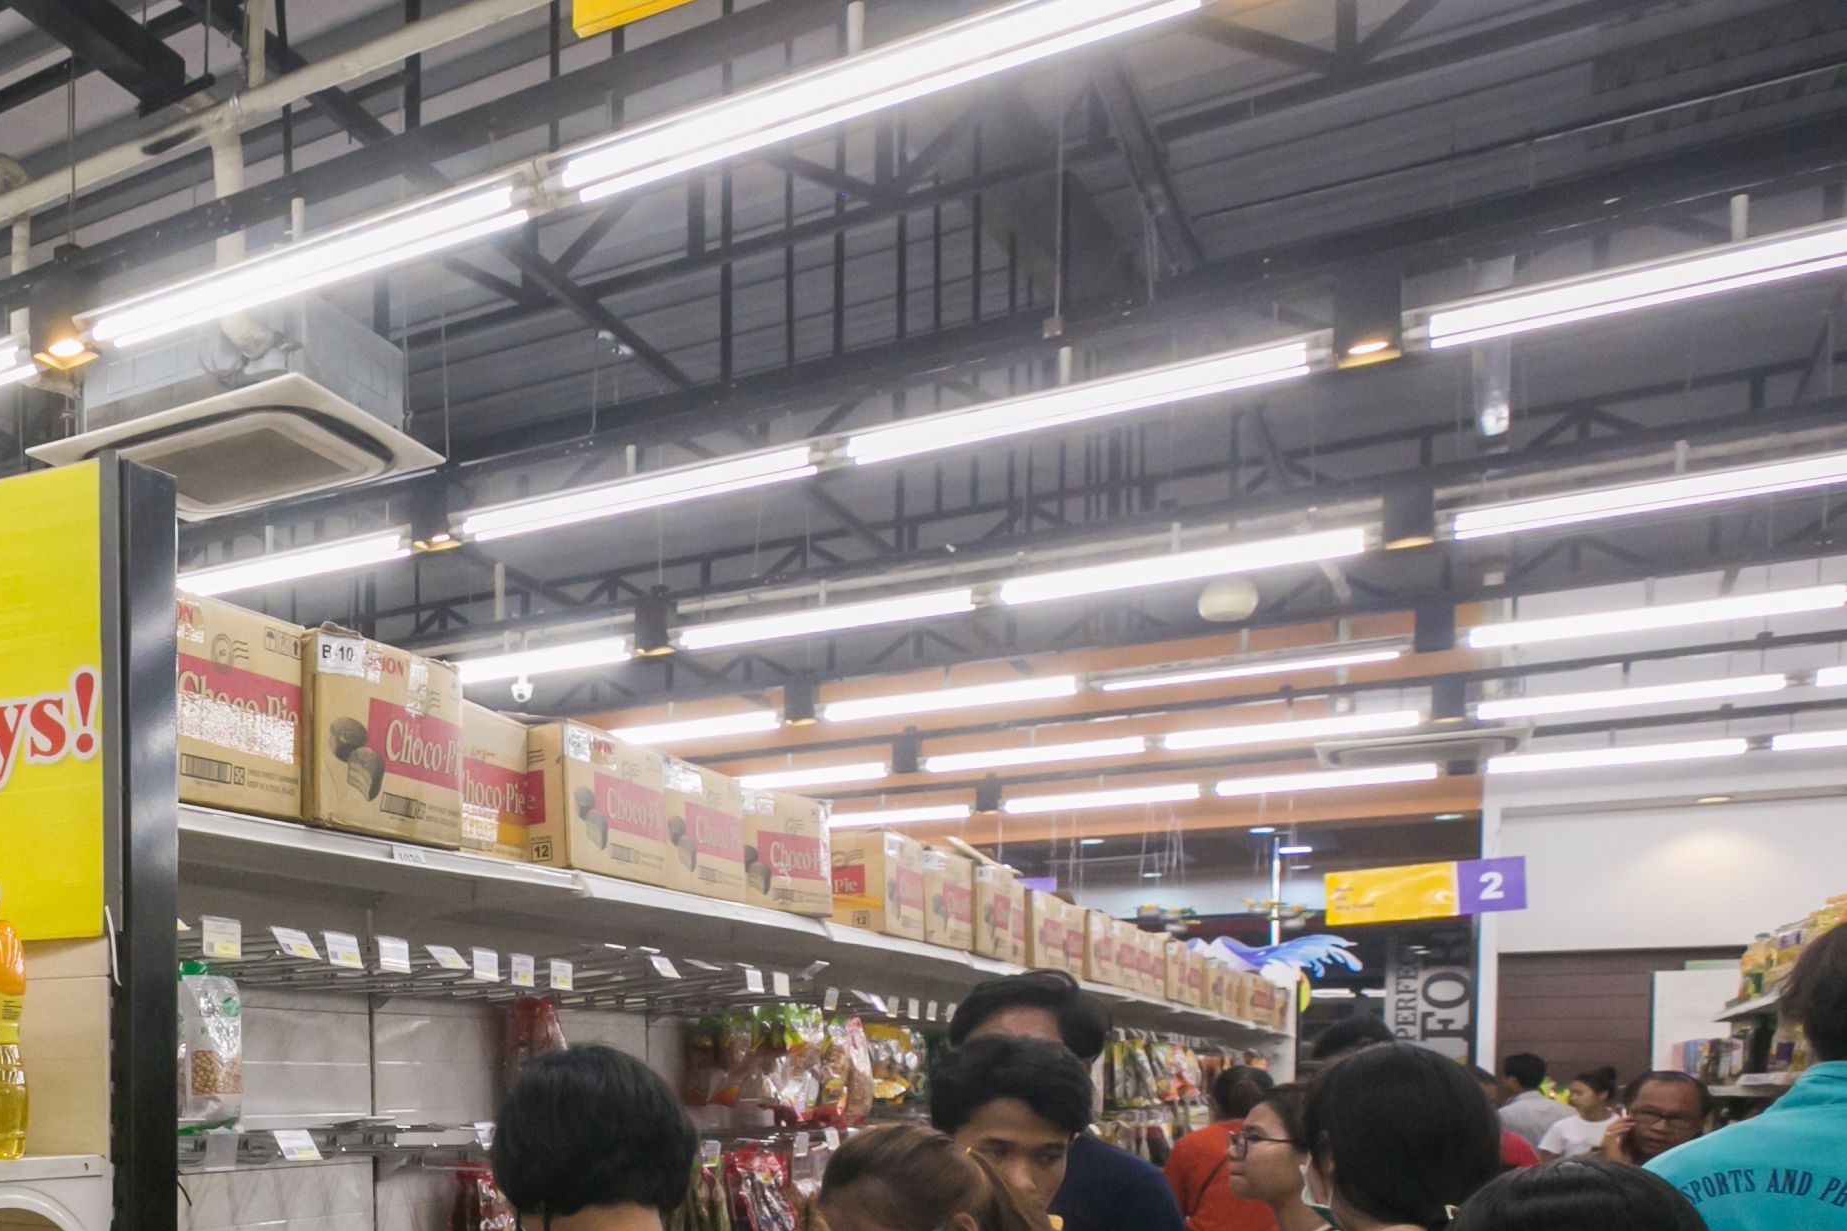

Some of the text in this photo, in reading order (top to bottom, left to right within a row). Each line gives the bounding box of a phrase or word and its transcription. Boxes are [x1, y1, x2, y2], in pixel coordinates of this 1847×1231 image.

[534, 845, 549, 858] 12
[1479, 871, 1505, 900] 2
[1681, 1168, 1755, 1205] SPORTS
[1766, 1168, 1812, 1197] AND
